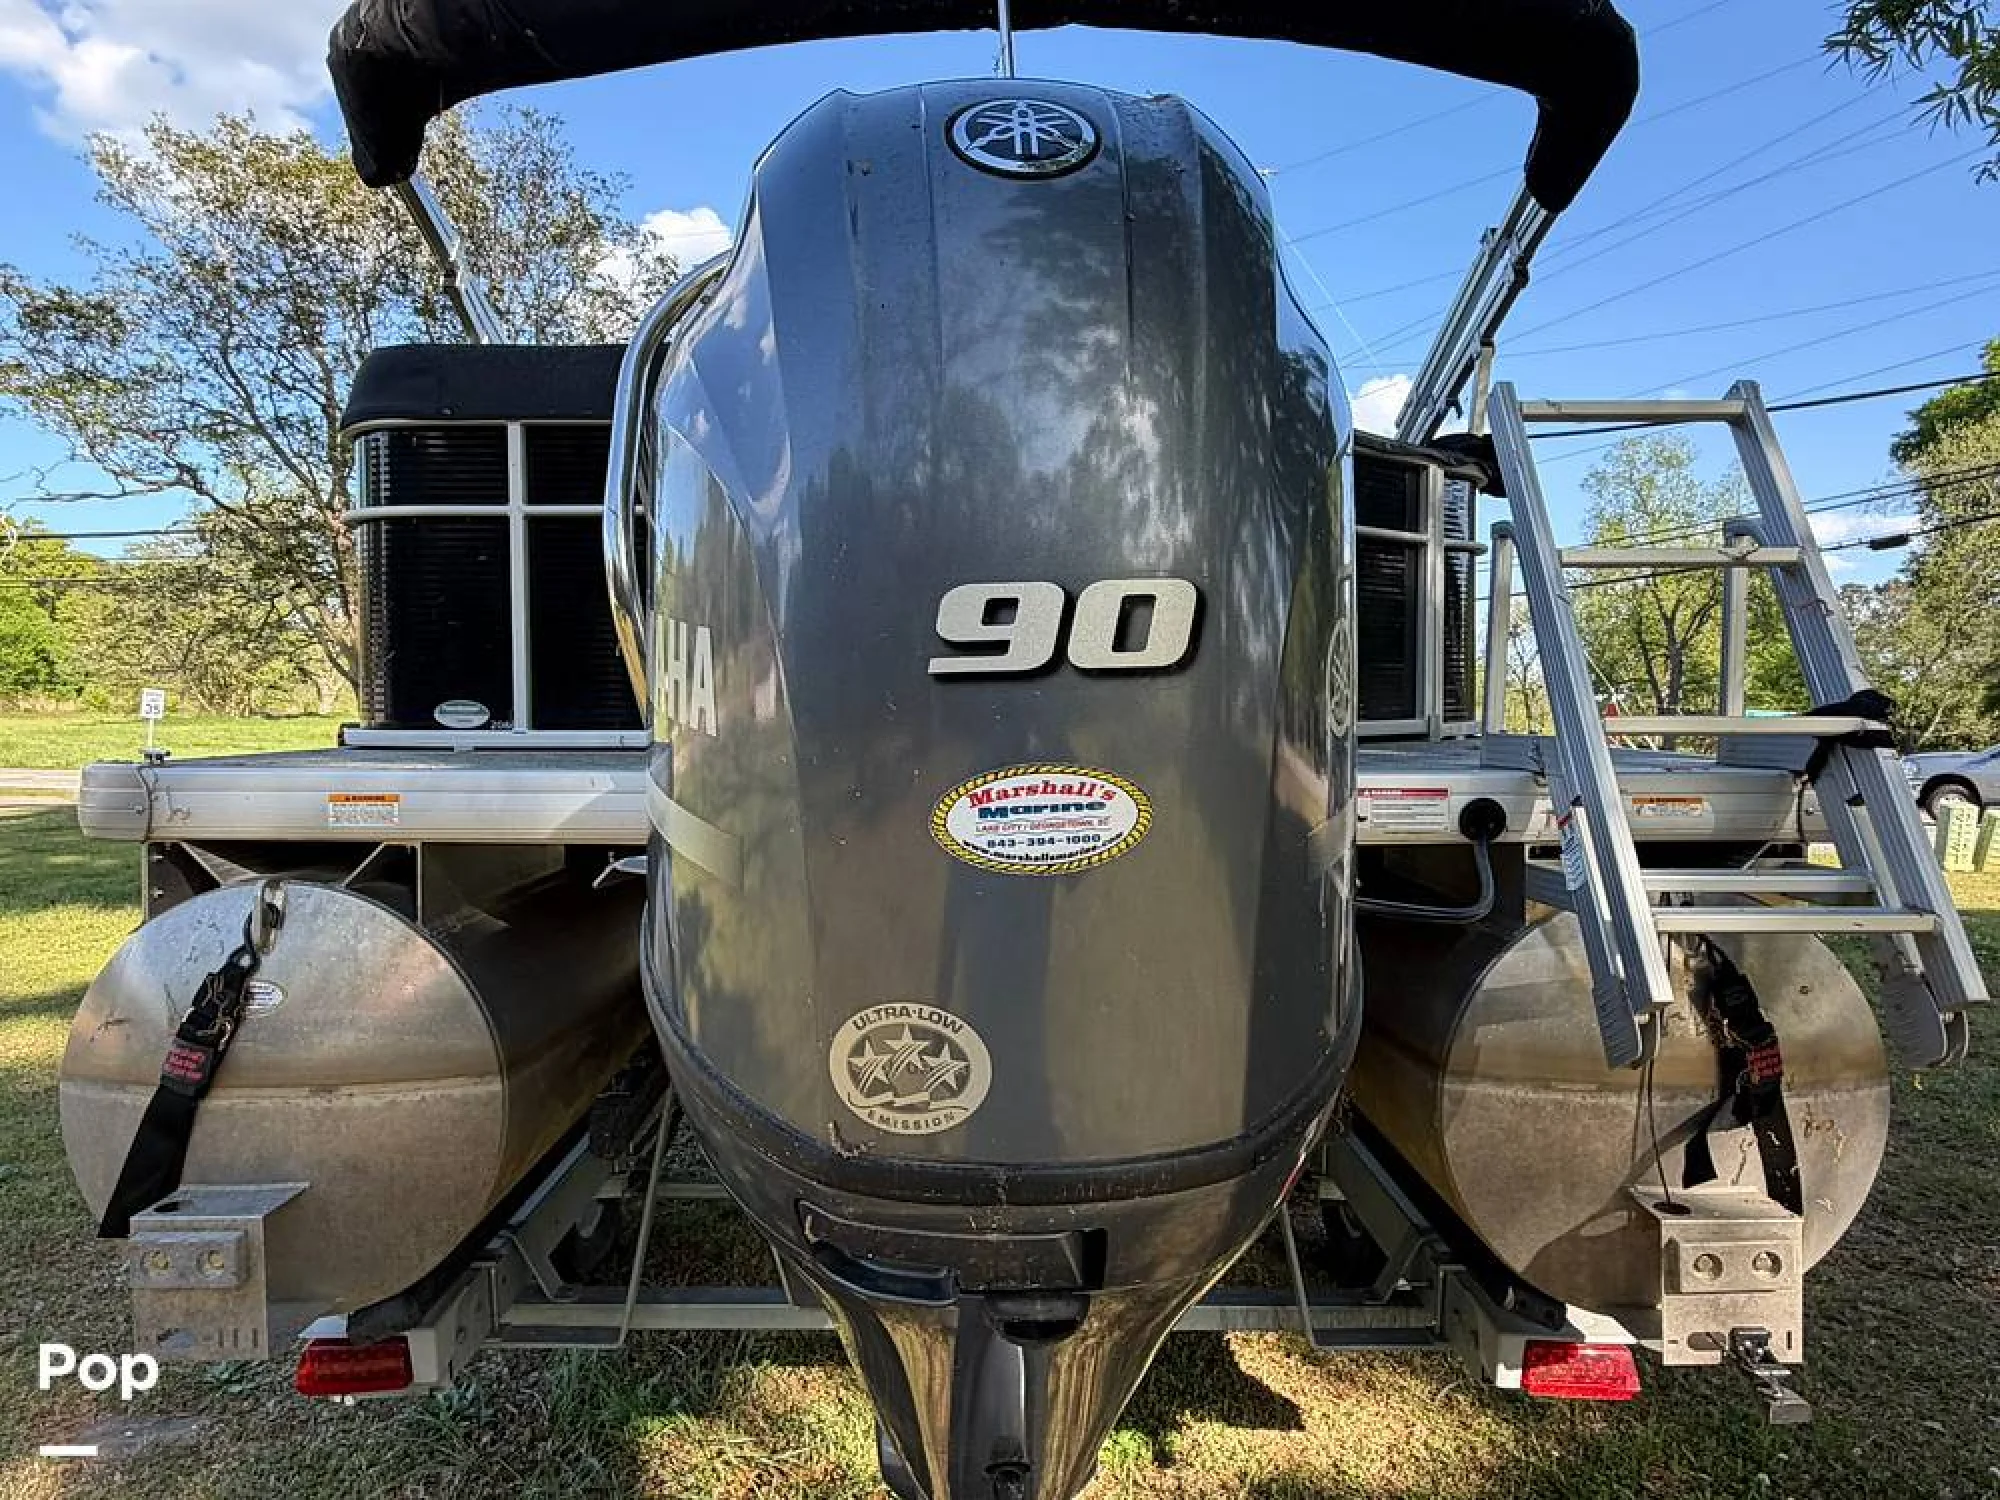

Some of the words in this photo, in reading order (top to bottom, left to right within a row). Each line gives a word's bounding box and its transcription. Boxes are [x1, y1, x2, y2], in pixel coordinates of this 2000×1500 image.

[928, 579, 1197, 674] 90
[969, 780, 1117, 808] Marshall's
[978, 801, 1107, 818] Marine
